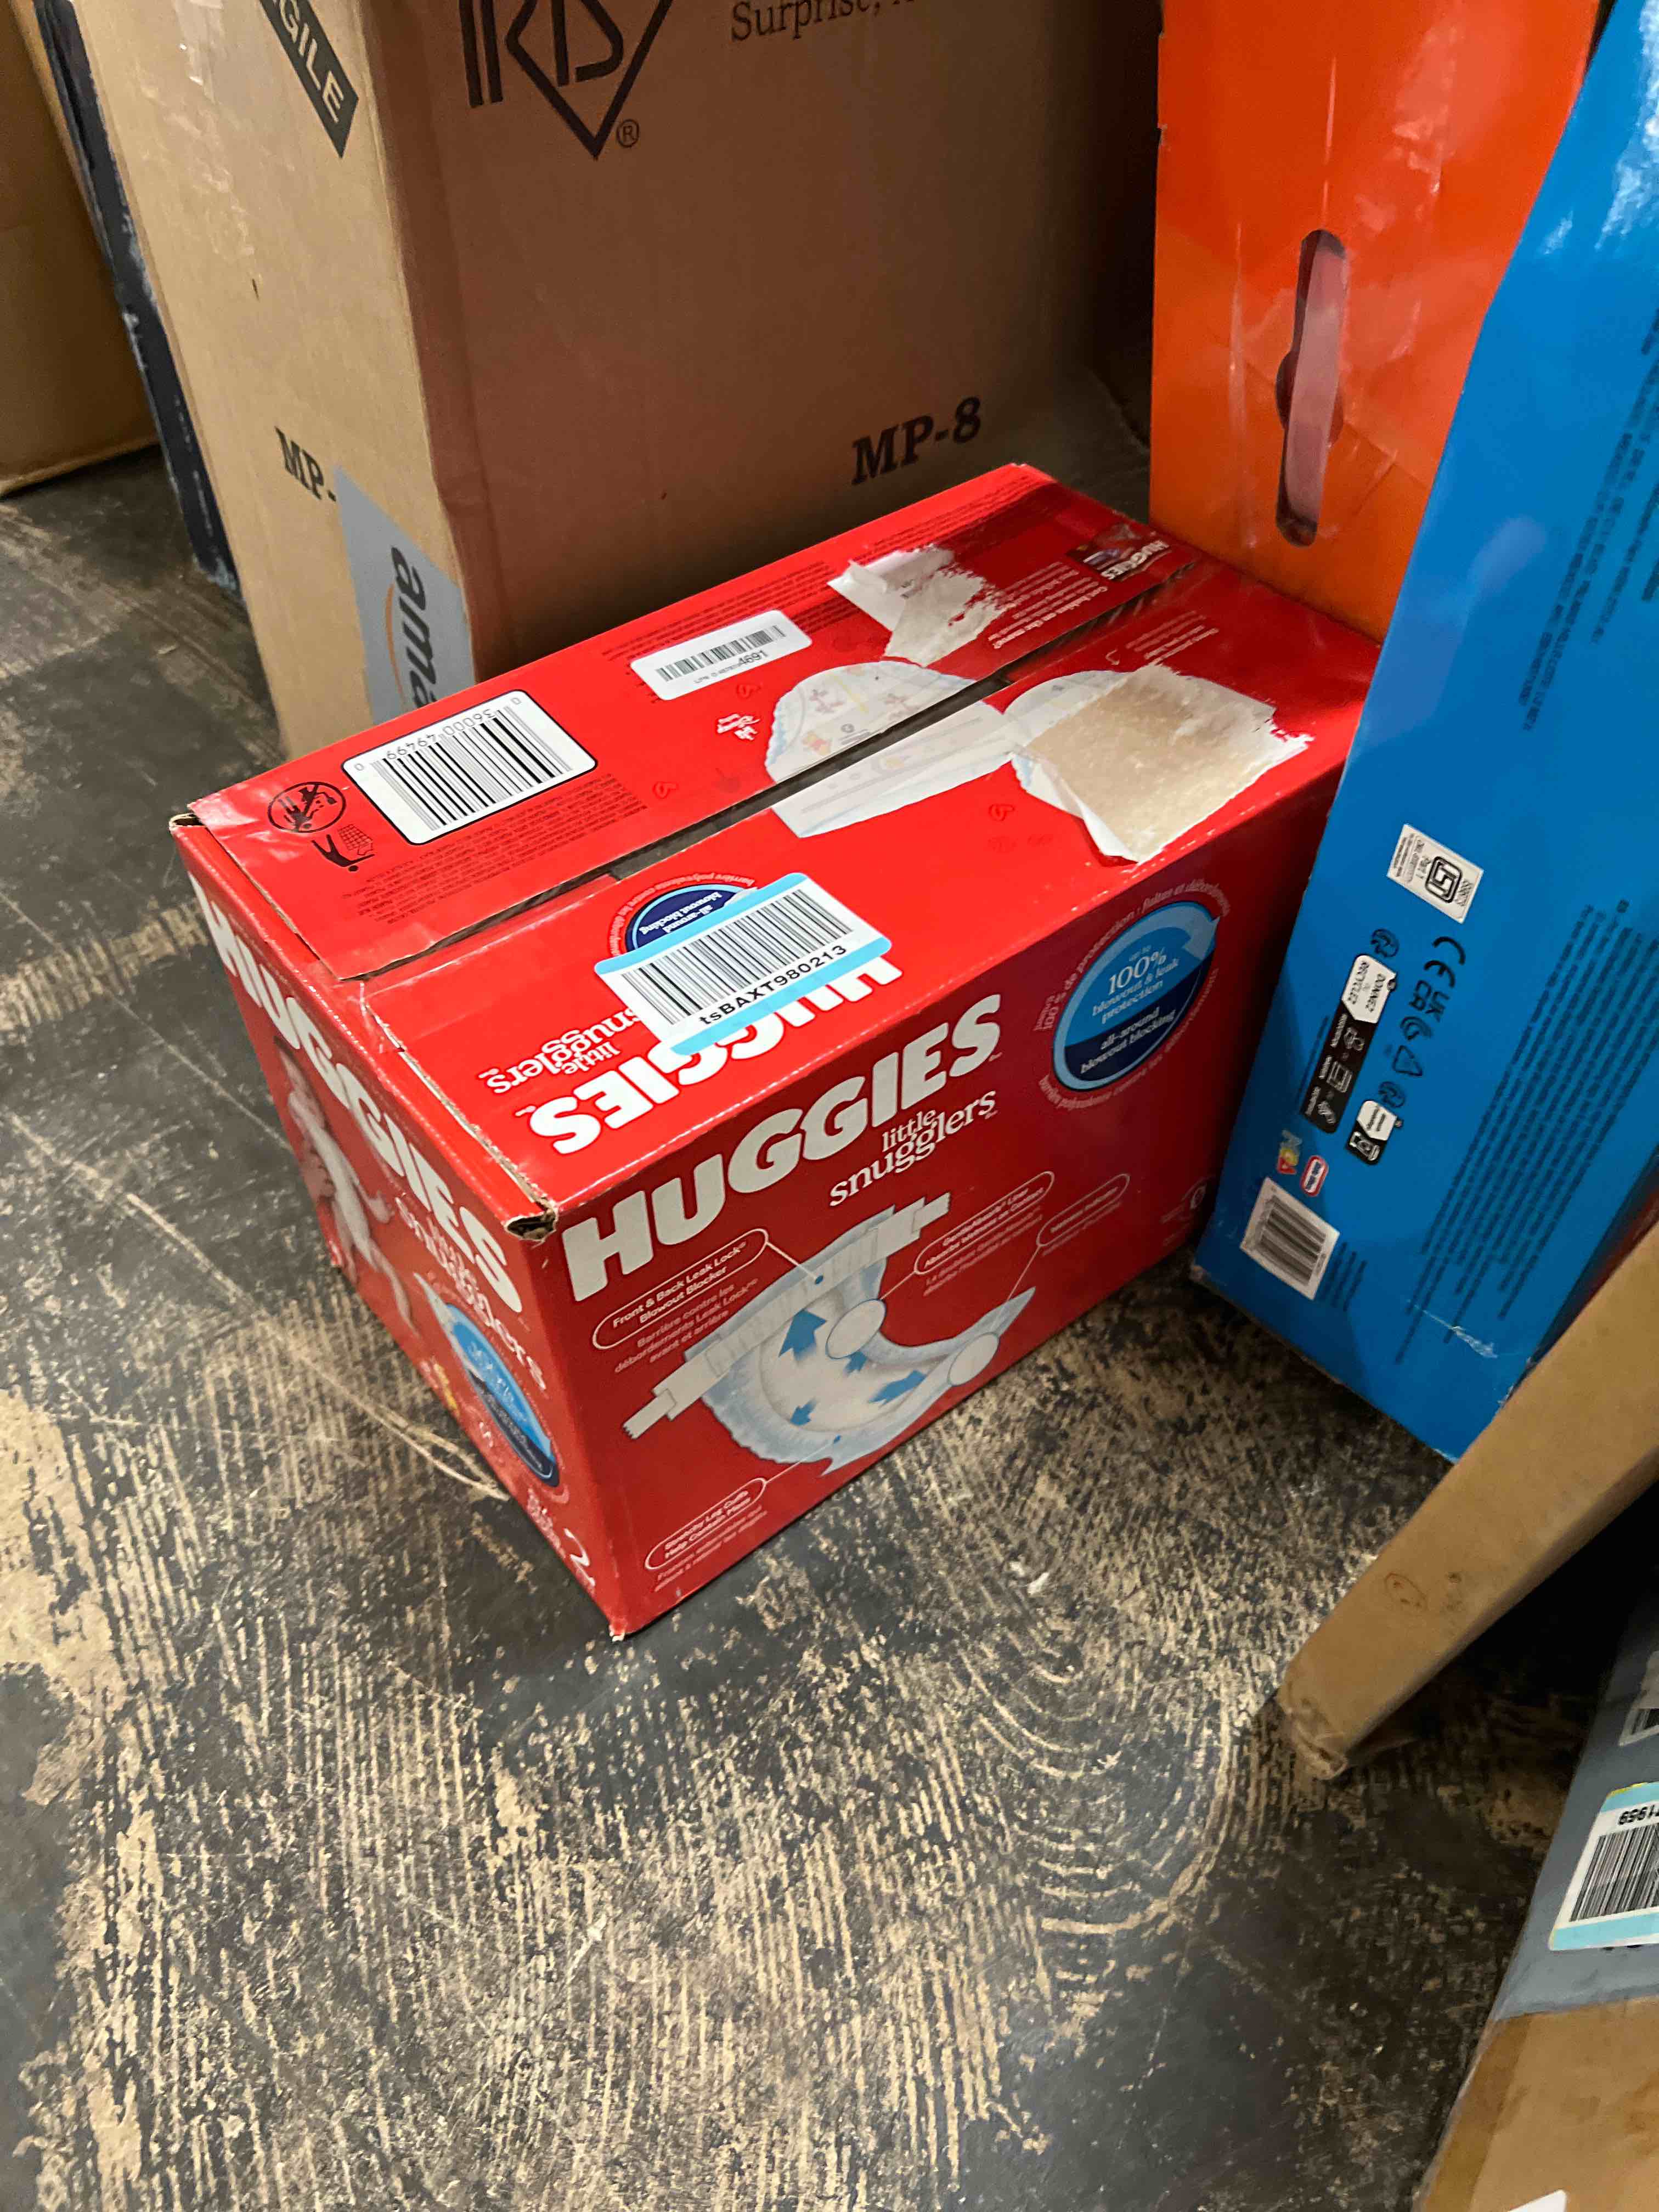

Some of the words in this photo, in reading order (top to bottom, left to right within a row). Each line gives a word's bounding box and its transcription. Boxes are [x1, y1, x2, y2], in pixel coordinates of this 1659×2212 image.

[851, 396, 980, 486] MP-8
[387, 734, 436, 760] 49499
[443, 709, 495, 736] 36000
[698, 944, 848, 1026] tsBAXT980213
[1108, 947, 1168, 996] 100%
[561, 1041, 621, 1075] little
[188, 870, 523, 1312] HUGGIES
[562, 994, 1002, 1302] HUGGIES
[829, 1090, 996, 1206] snugglers
[882, 1109, 936, 1152] little
[613, 1305, 644, 1328] Front
[646, 1297, 654, 1308] &
[656, 1280, 685, 1302] Back
[686, 1263, 713, 1284] Leak
[639, 1291, 685, 1324] Blowout
[686, 1266, 729, 1295] Blocker
